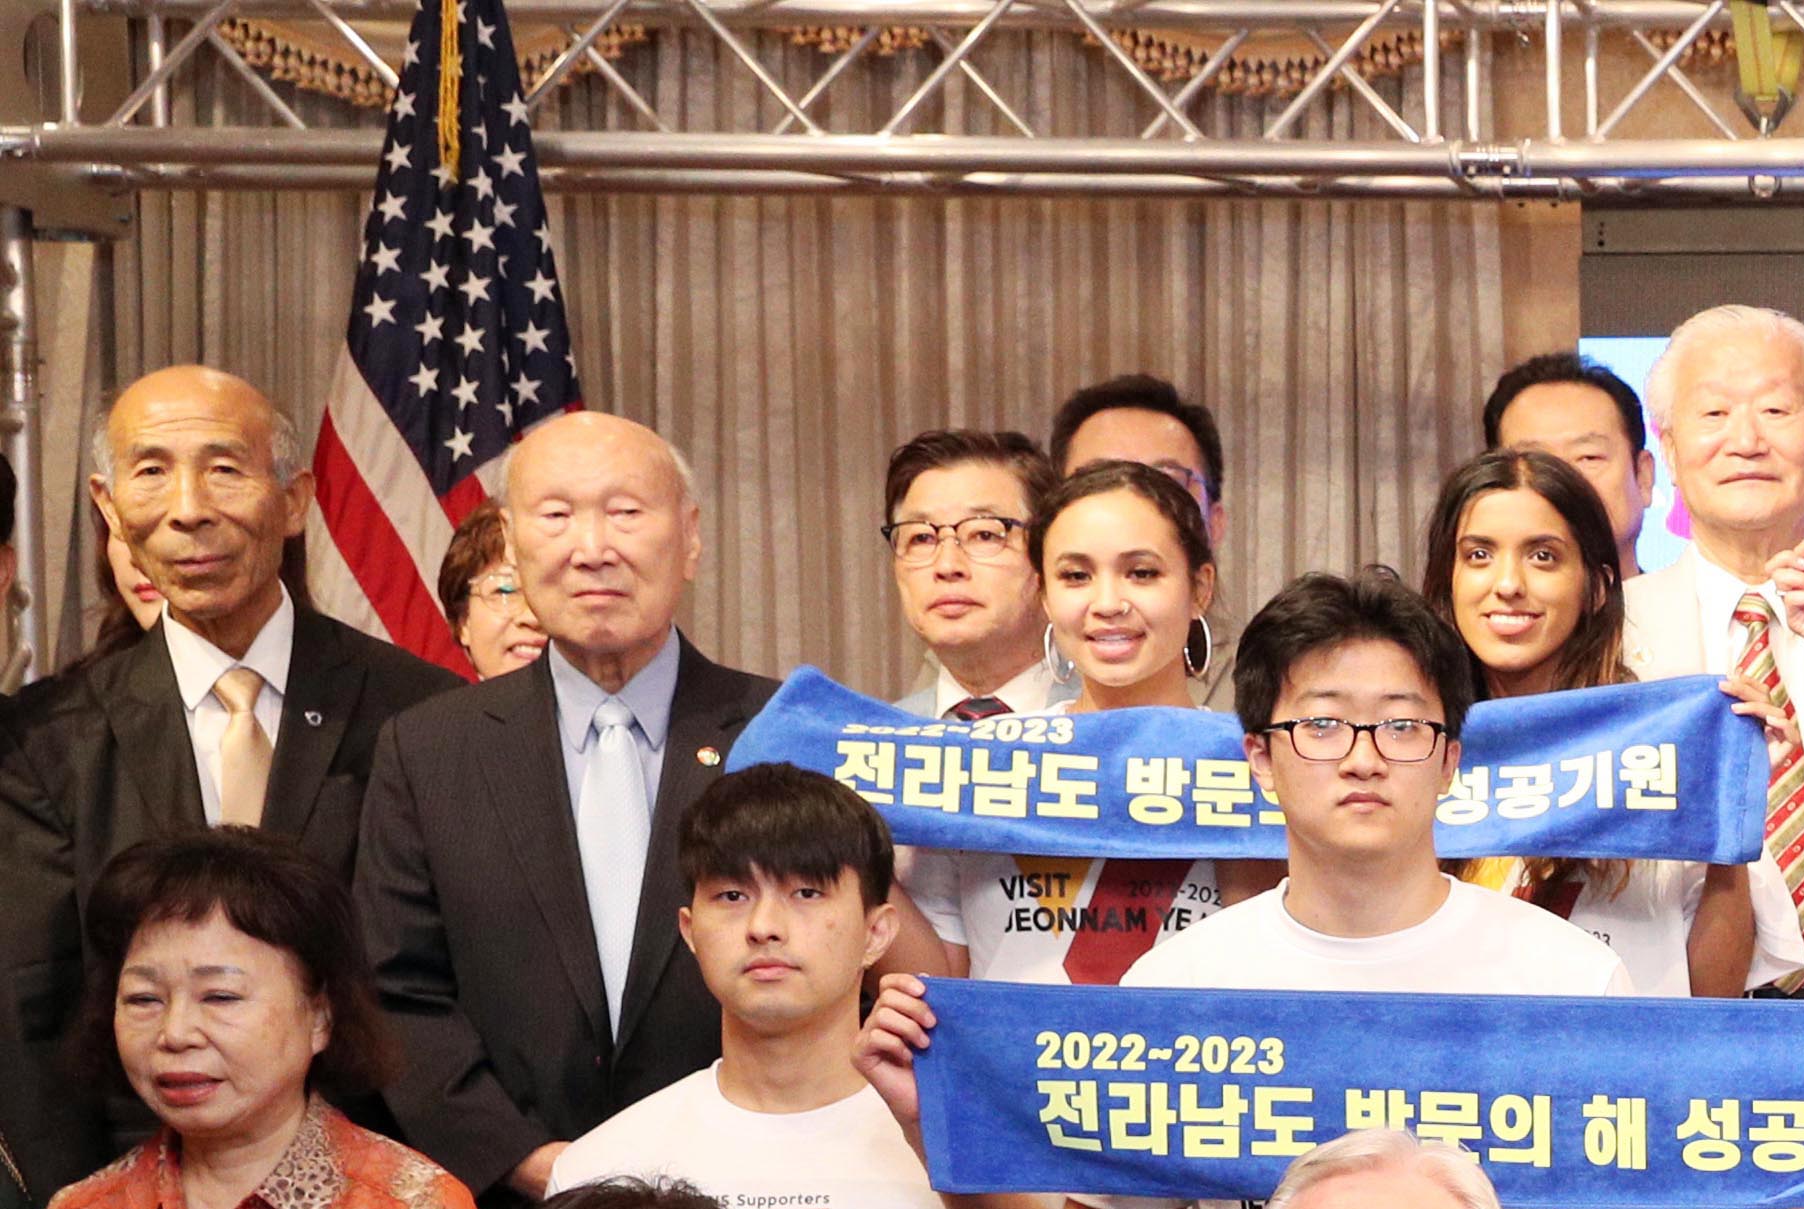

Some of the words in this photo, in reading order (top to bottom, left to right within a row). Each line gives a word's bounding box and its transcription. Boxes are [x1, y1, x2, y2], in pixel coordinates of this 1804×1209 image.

[834, 740, 1098, 819] 전라남도
[1435, 743, 1677, 825] 성공기원
[1000, 873, 1070, 900] VISIT
[1005, 907, 1147, 933] JEONNAM
[1036, 1031, 1285, 1074] 2022~2023
[1036, 1079, 1316, 1158] 전라남도
[1583, 1095, 1646, 1170] 해
[737, 1193, 830, 1209] Supporters
